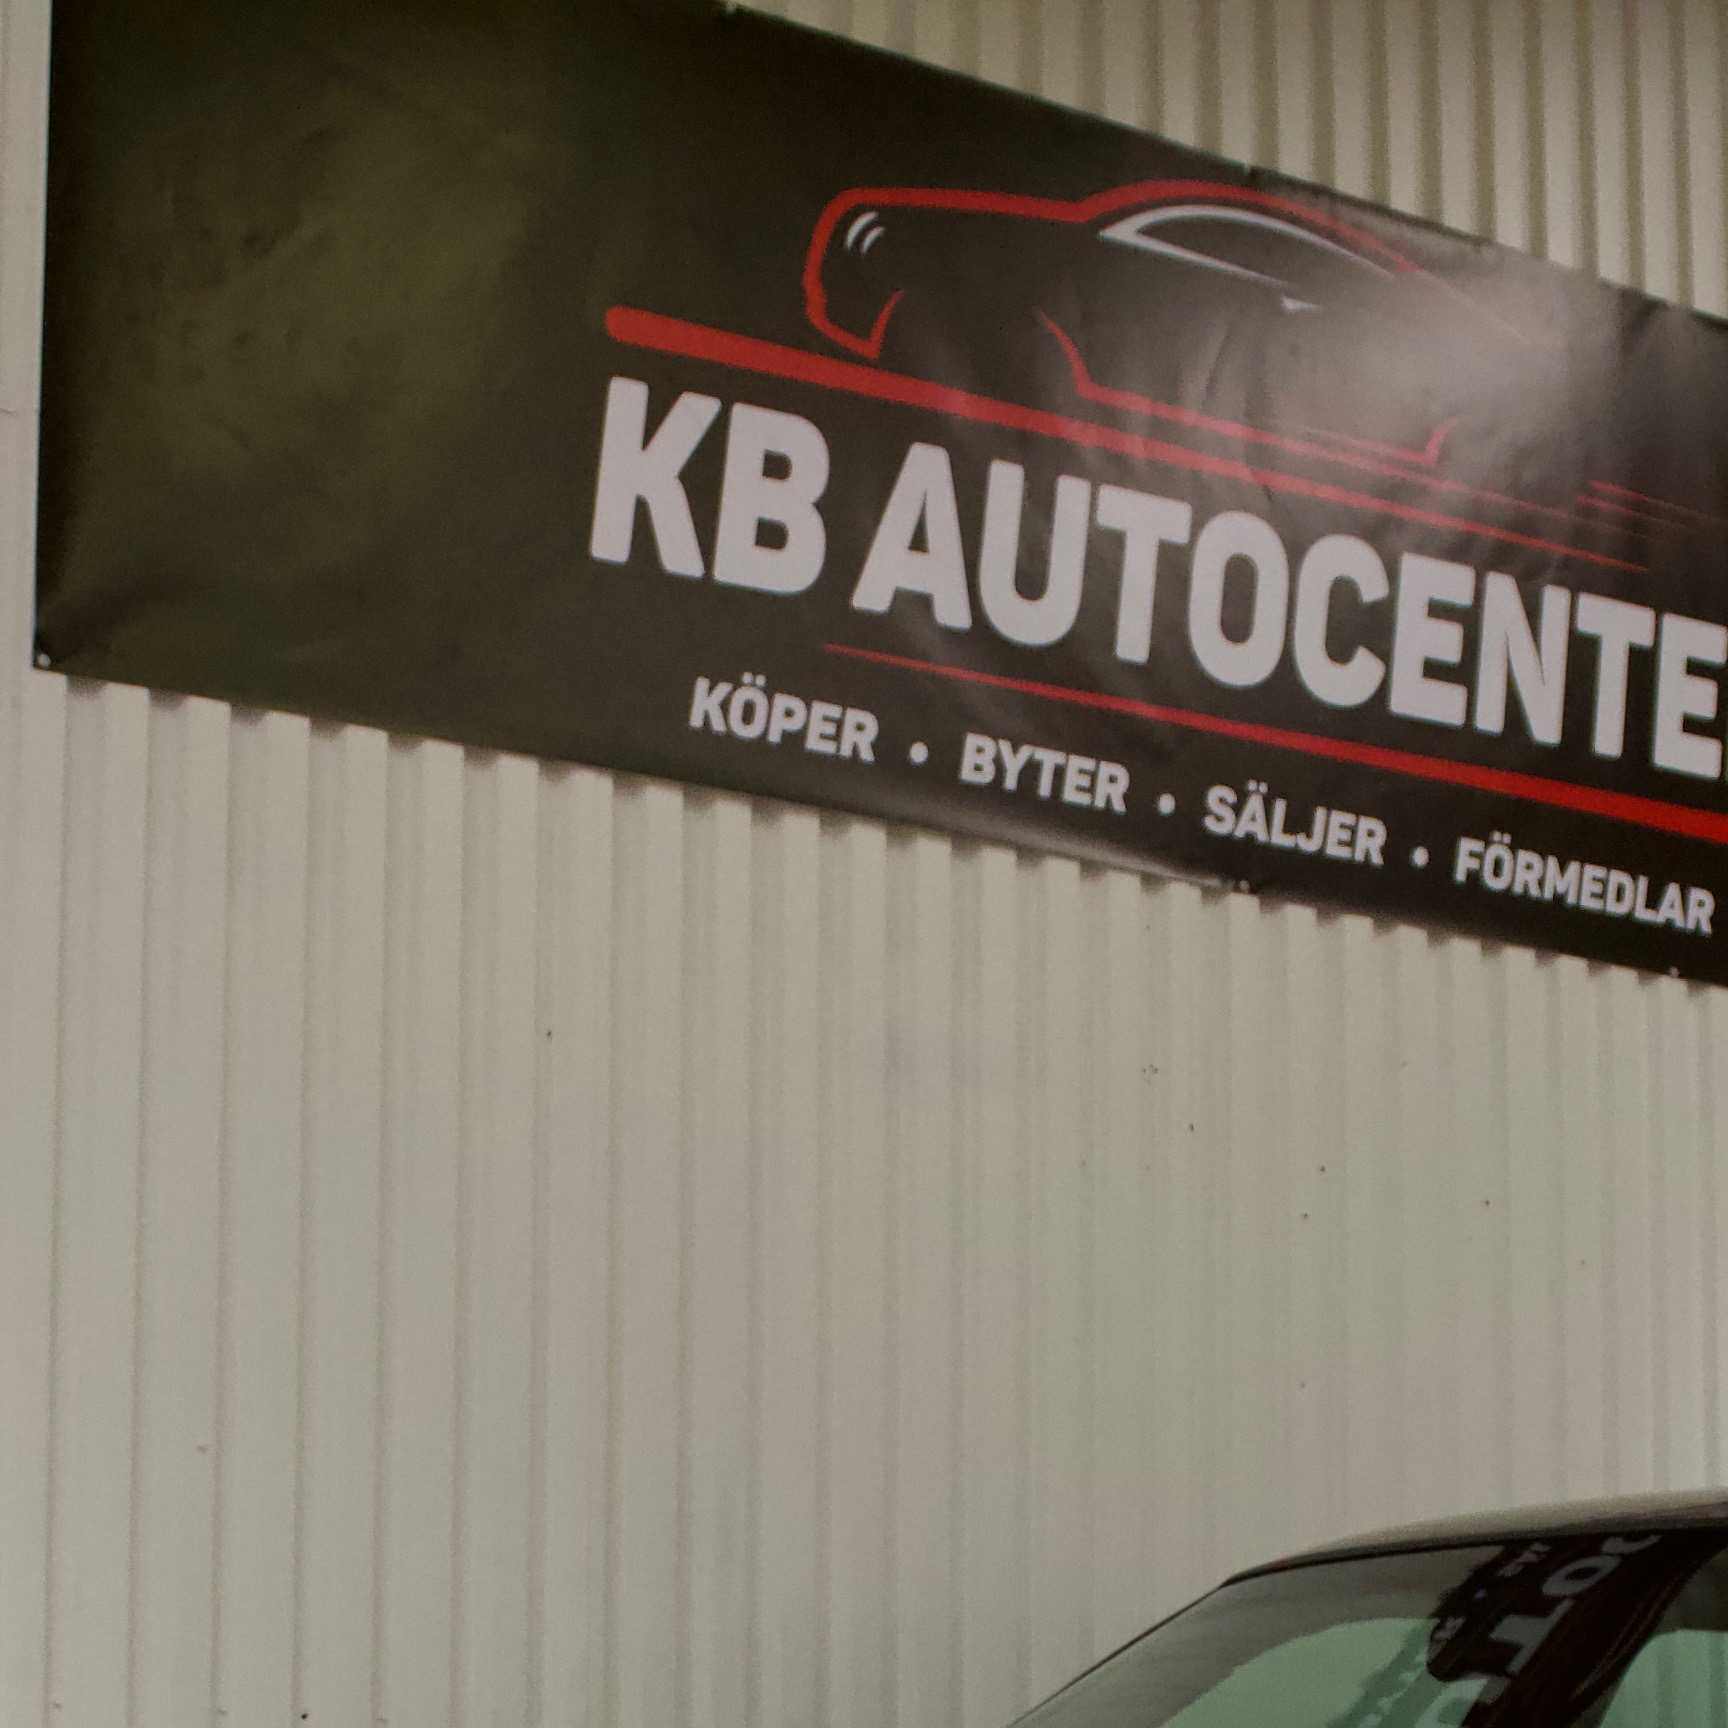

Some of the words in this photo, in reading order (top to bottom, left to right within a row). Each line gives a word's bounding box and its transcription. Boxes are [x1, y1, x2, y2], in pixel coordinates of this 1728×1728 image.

[591, 377, 829, 594] KB
[690, 673, 878, 761] KÖPER
[960, 733, 1129, 812] BYTER
[1204, 778, 1386, 865] SÄLJER
[1455, 831, 1714, 933] FÖRMEDLAR
